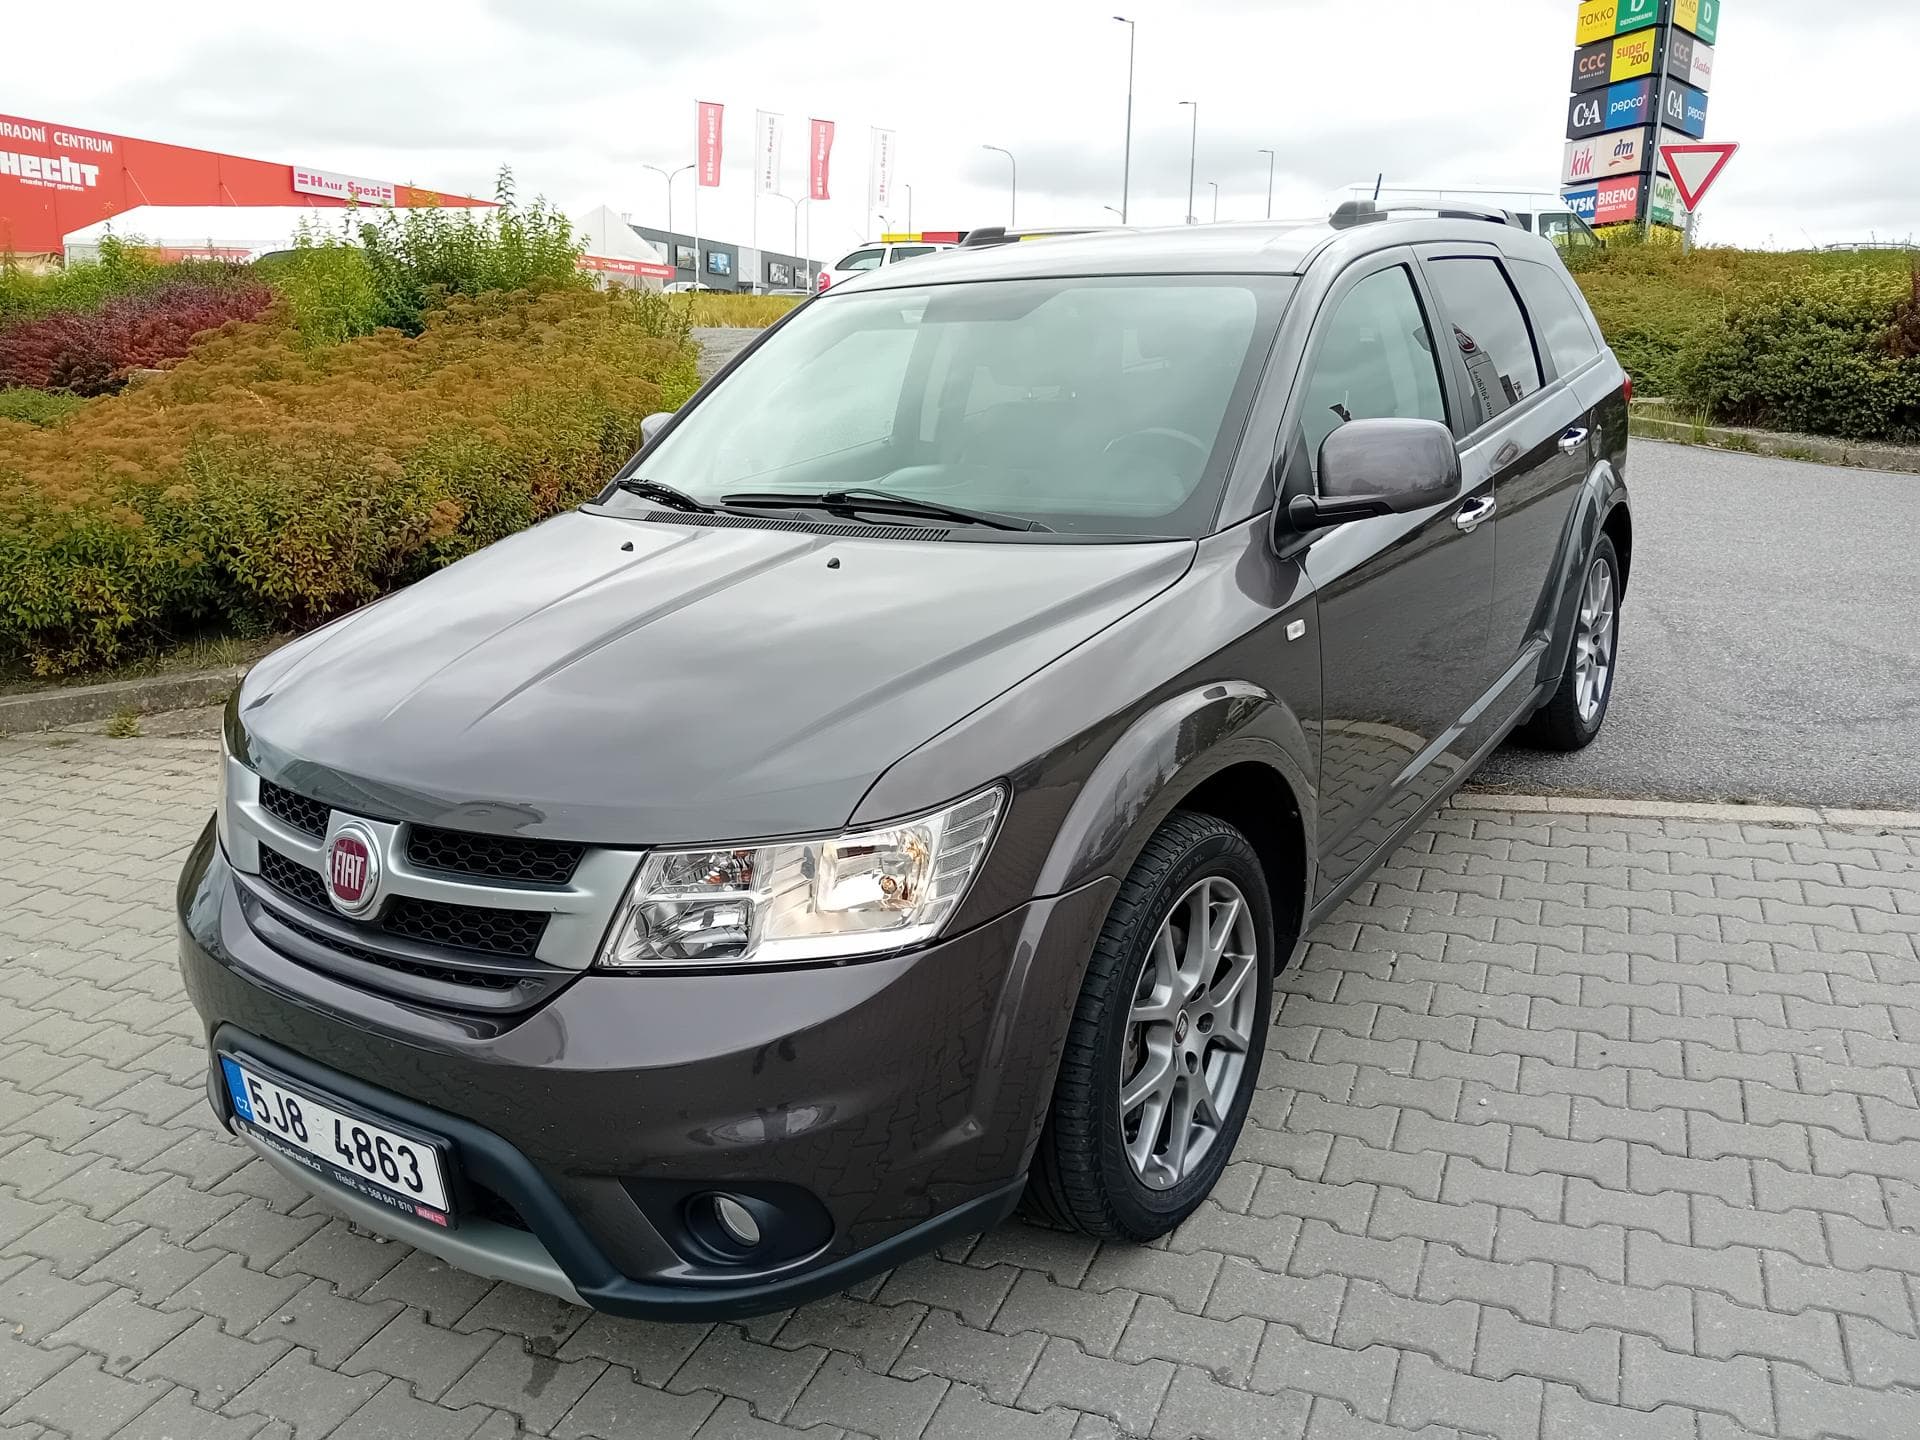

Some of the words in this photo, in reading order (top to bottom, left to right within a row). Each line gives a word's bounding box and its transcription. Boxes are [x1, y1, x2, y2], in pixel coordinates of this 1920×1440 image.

[1580, 7, 1615, 26] TOKKO
[1616, 41, 1647, 58] super
[1674, 42, 1690, 62] CCC
[1579, 53, 1606, 73] CCC
[1630, 52, 1650, 66] zoo
[1573, 100, 1602, 127] C&A
[1611, 97, 1643, 115] pepco
[1667, 90, 1683, 120] C&A
[1687, 105, 1706, 121] pepco
[53, 131, 113, 154] CENTRUM
[1614, 139, 1634, 157] dm
[20, 178, 43, 187] made
[43, 181, 57, 189] for
[57, 184, 84, 192] garden
[347, 181, 381, 198] Spezi
[1597, 187, 1637, 205] BRENO
[334, 850, 365, 891] FIAT
[236, 1097, 250, 1113] CZ
[248, 1077, 308, 1143] 5J8
[334, 1118, 423, 1194] 4863
